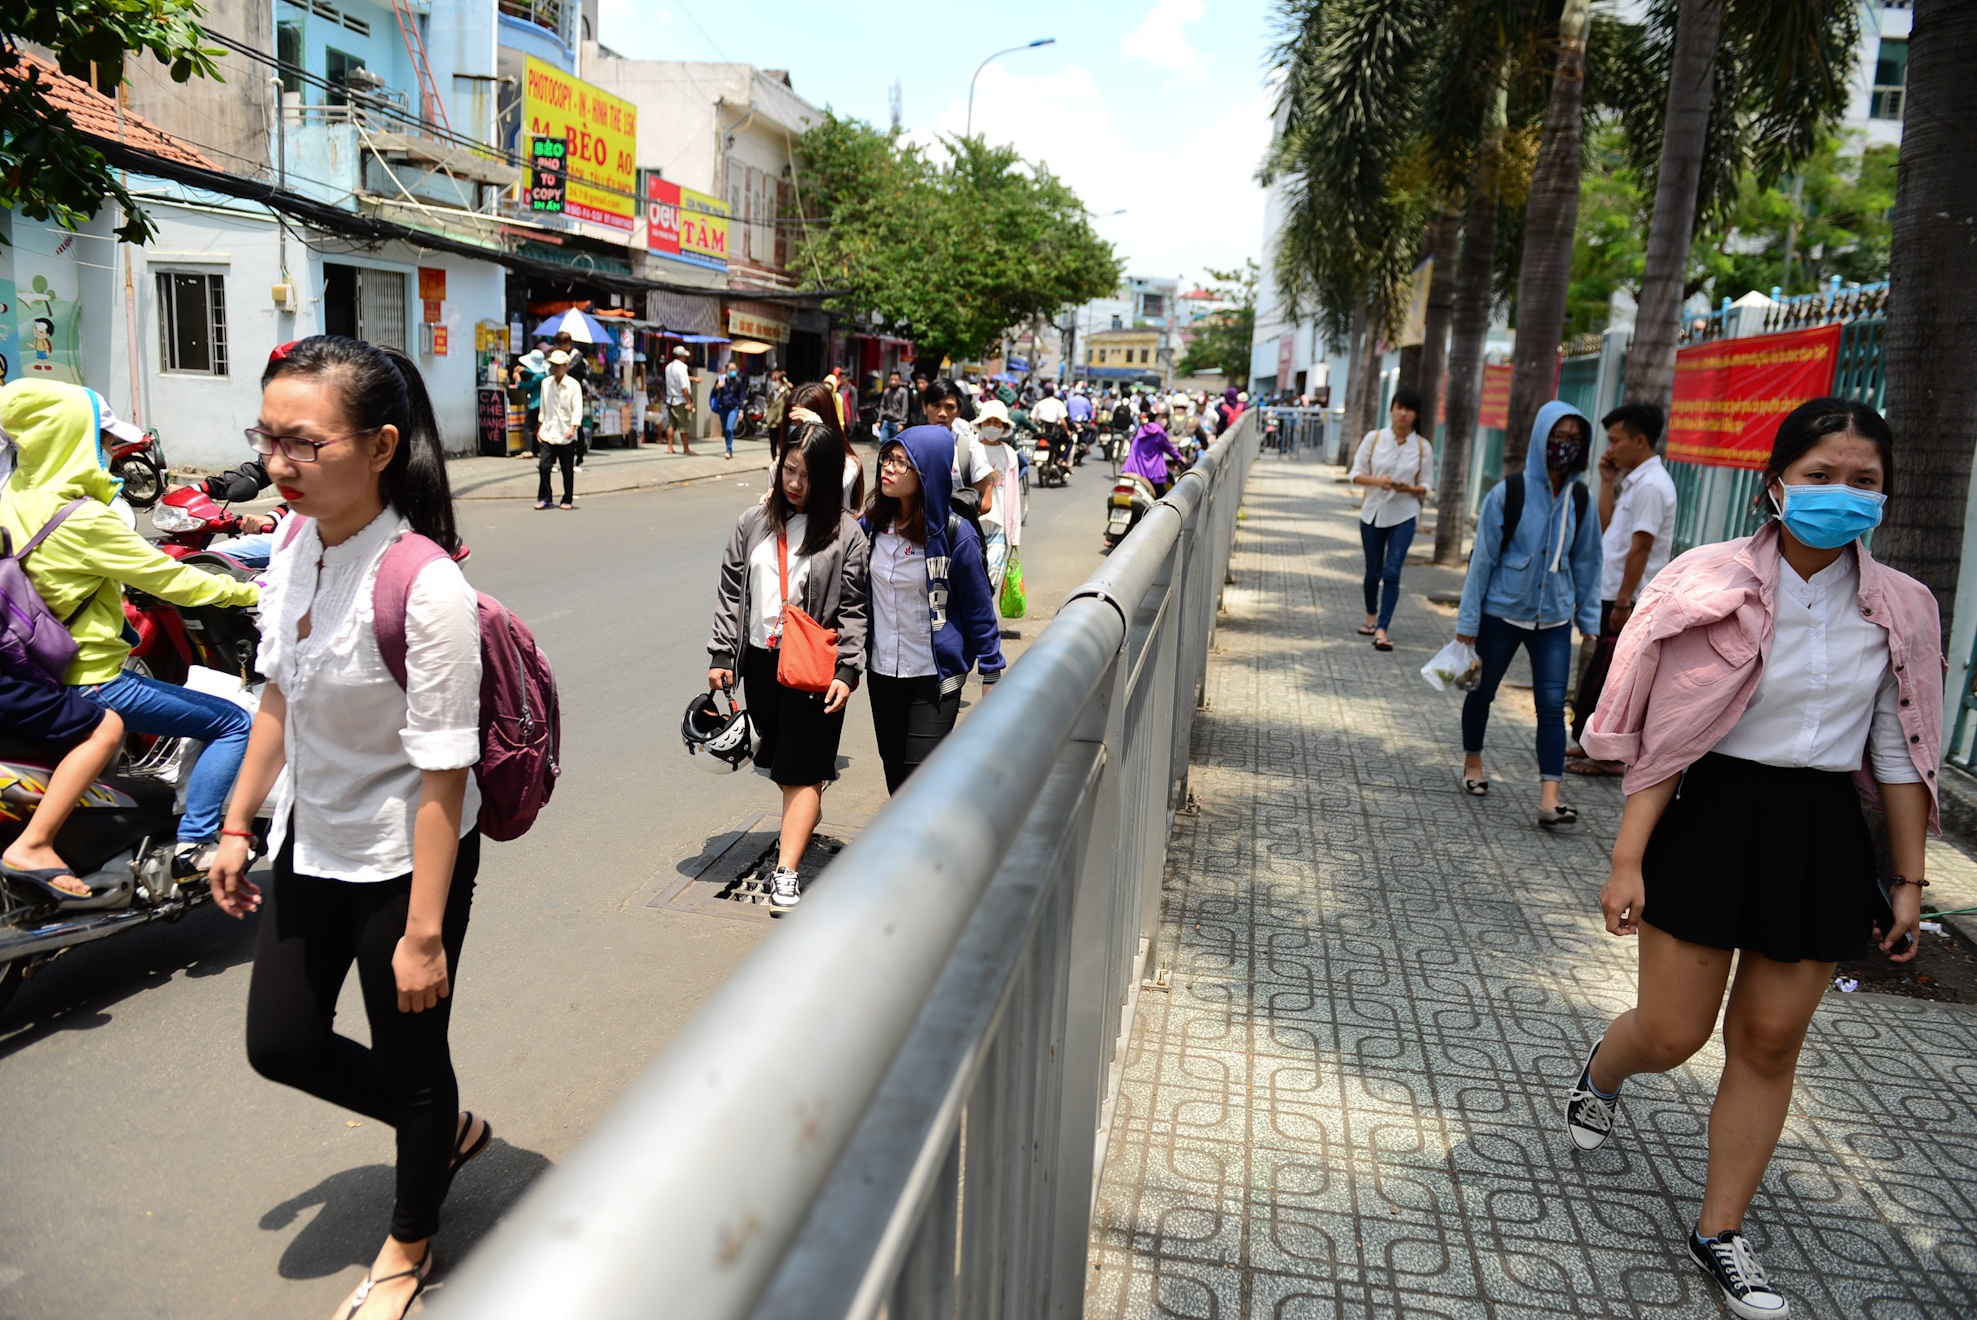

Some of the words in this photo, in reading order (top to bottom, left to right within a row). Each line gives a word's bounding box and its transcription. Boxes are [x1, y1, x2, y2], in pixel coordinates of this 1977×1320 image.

[528, 68, 572, 112] PHOTOCOPY
[579, 91, 586, 117] IN
[534, 139, 565, 158] BÈO
[565, 122, 607, 166] BÈO
[540, 172, 557, 187] TO
[532, 186, 563, 202] COPY
[683, 217, 727, 255] TÂM
